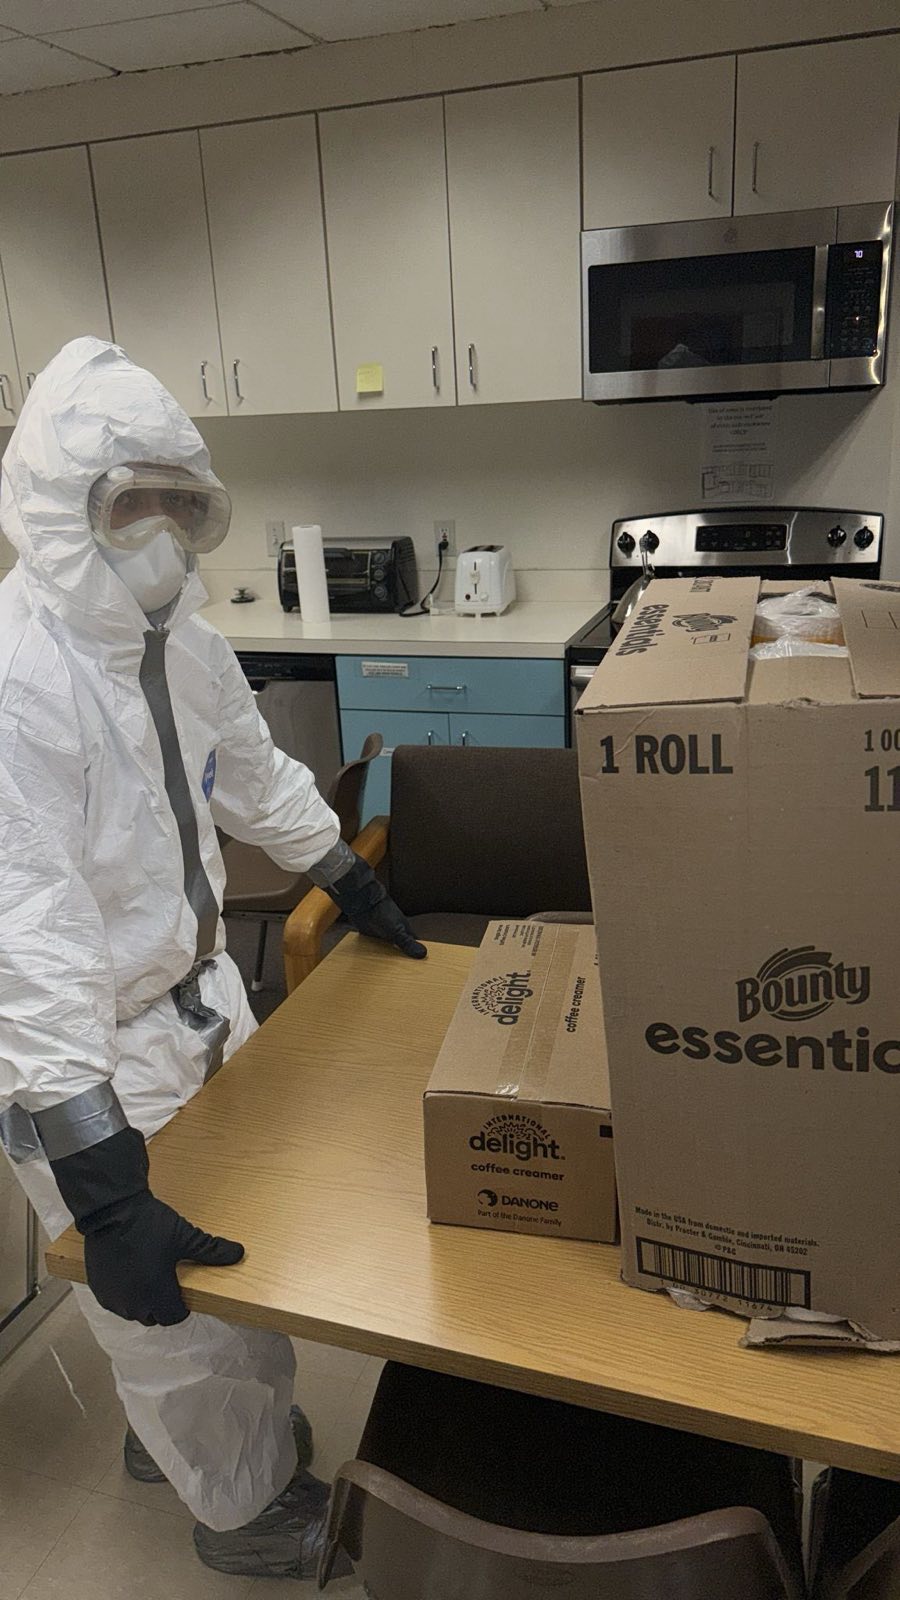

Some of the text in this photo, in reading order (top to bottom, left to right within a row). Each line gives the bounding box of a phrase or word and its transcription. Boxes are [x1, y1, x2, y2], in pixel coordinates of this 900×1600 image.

[615, 604, 669, 656] essentials
[600, 733, 733, 775] 1 ROLL
[471, 976, 505, 1016] INTERNATIONAL
[564, 976, 587, 1033] coffee creamer
[736, 961, 871, 1022] Bounty
[483, 1114, 550, 1140] INTERNATIONAL
[471, 1163, 565, 1181] coffee creamer
[477, 1209, 562, 1227] Part of the Danone Family
[635, 1206, 652, 1217] Made
[661, 1212, 672, 1221] the
[674, 1215, 687, 1224] USA
[688, 1218, 704, 1229] from
[705, 1223, 735, 1236] domestic
[737, 1230, 750, 1239] and
[751, 1231, 783, 1243] imported
[666, 1222, 674, 1232] by
[675, 1225, 700, 1237] Procter
